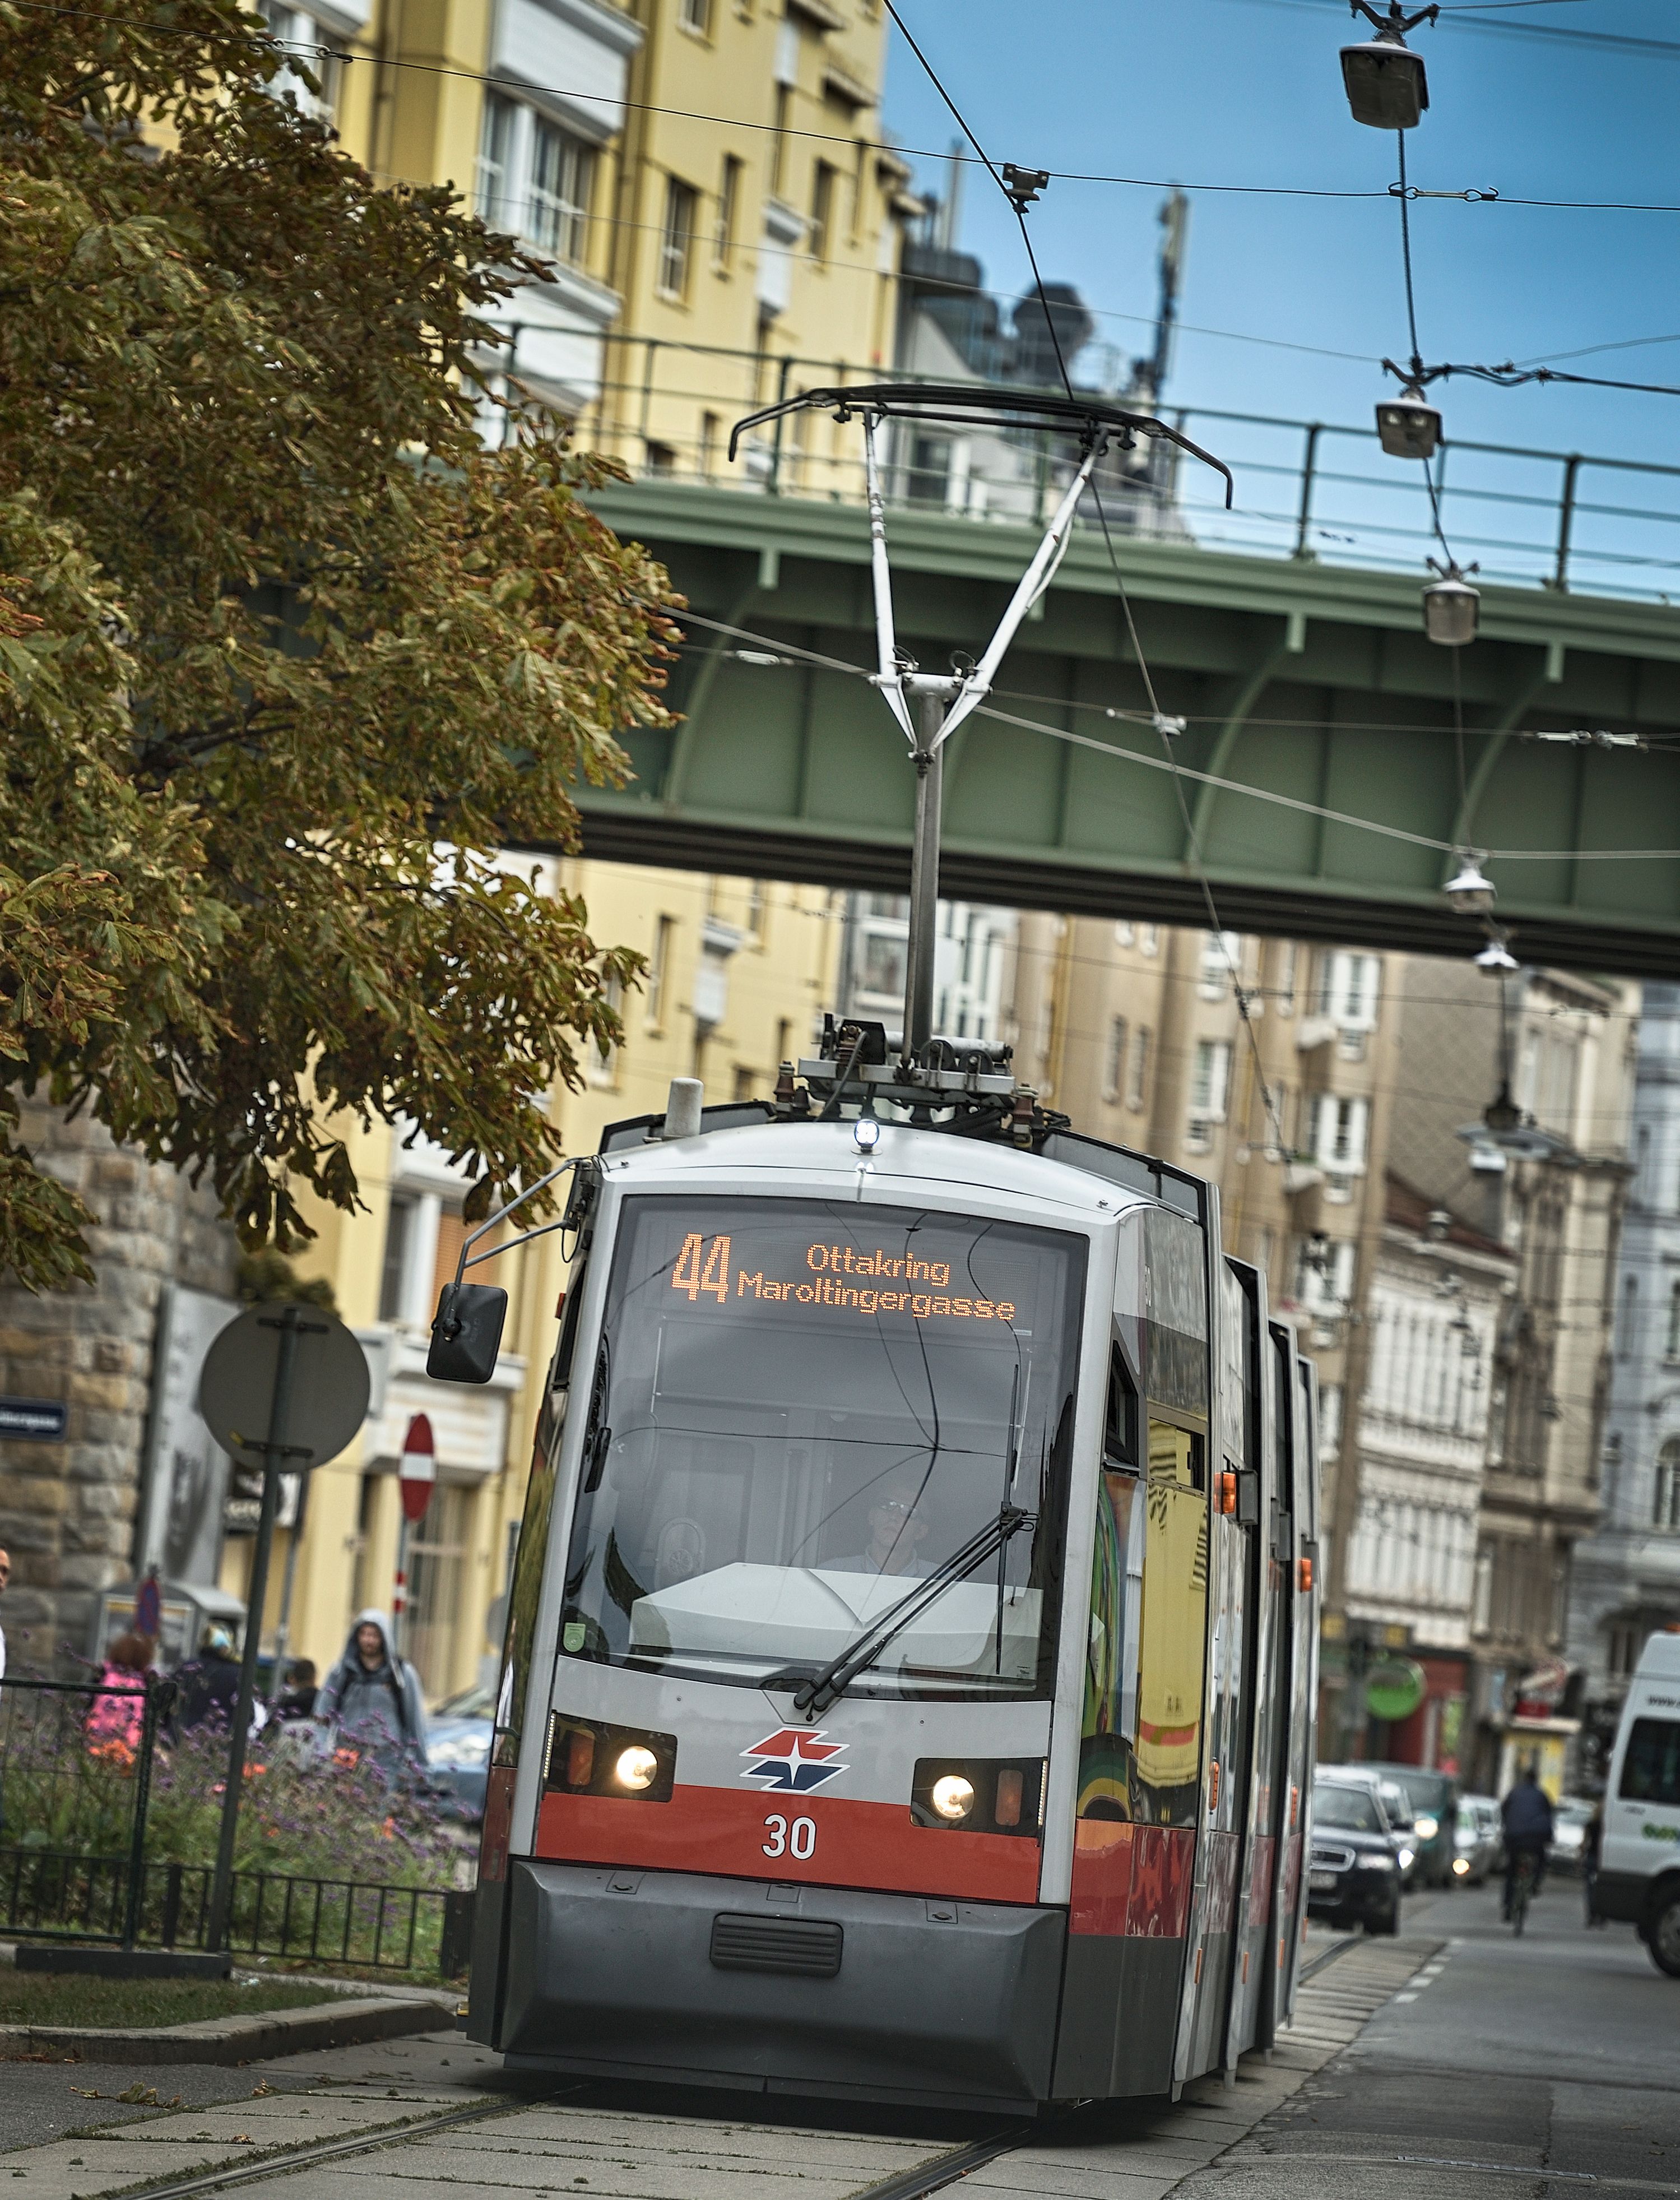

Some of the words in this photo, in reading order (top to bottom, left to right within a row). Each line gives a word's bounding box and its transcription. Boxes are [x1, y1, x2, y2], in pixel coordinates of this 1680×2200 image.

[672, 1233, 731, 1304] 44
[806, 1244, 951, 1287] Ottakring
[737, 1271, 1016, 1321] Maroltingergasse
[762, 1814, 816, 1860] 30
